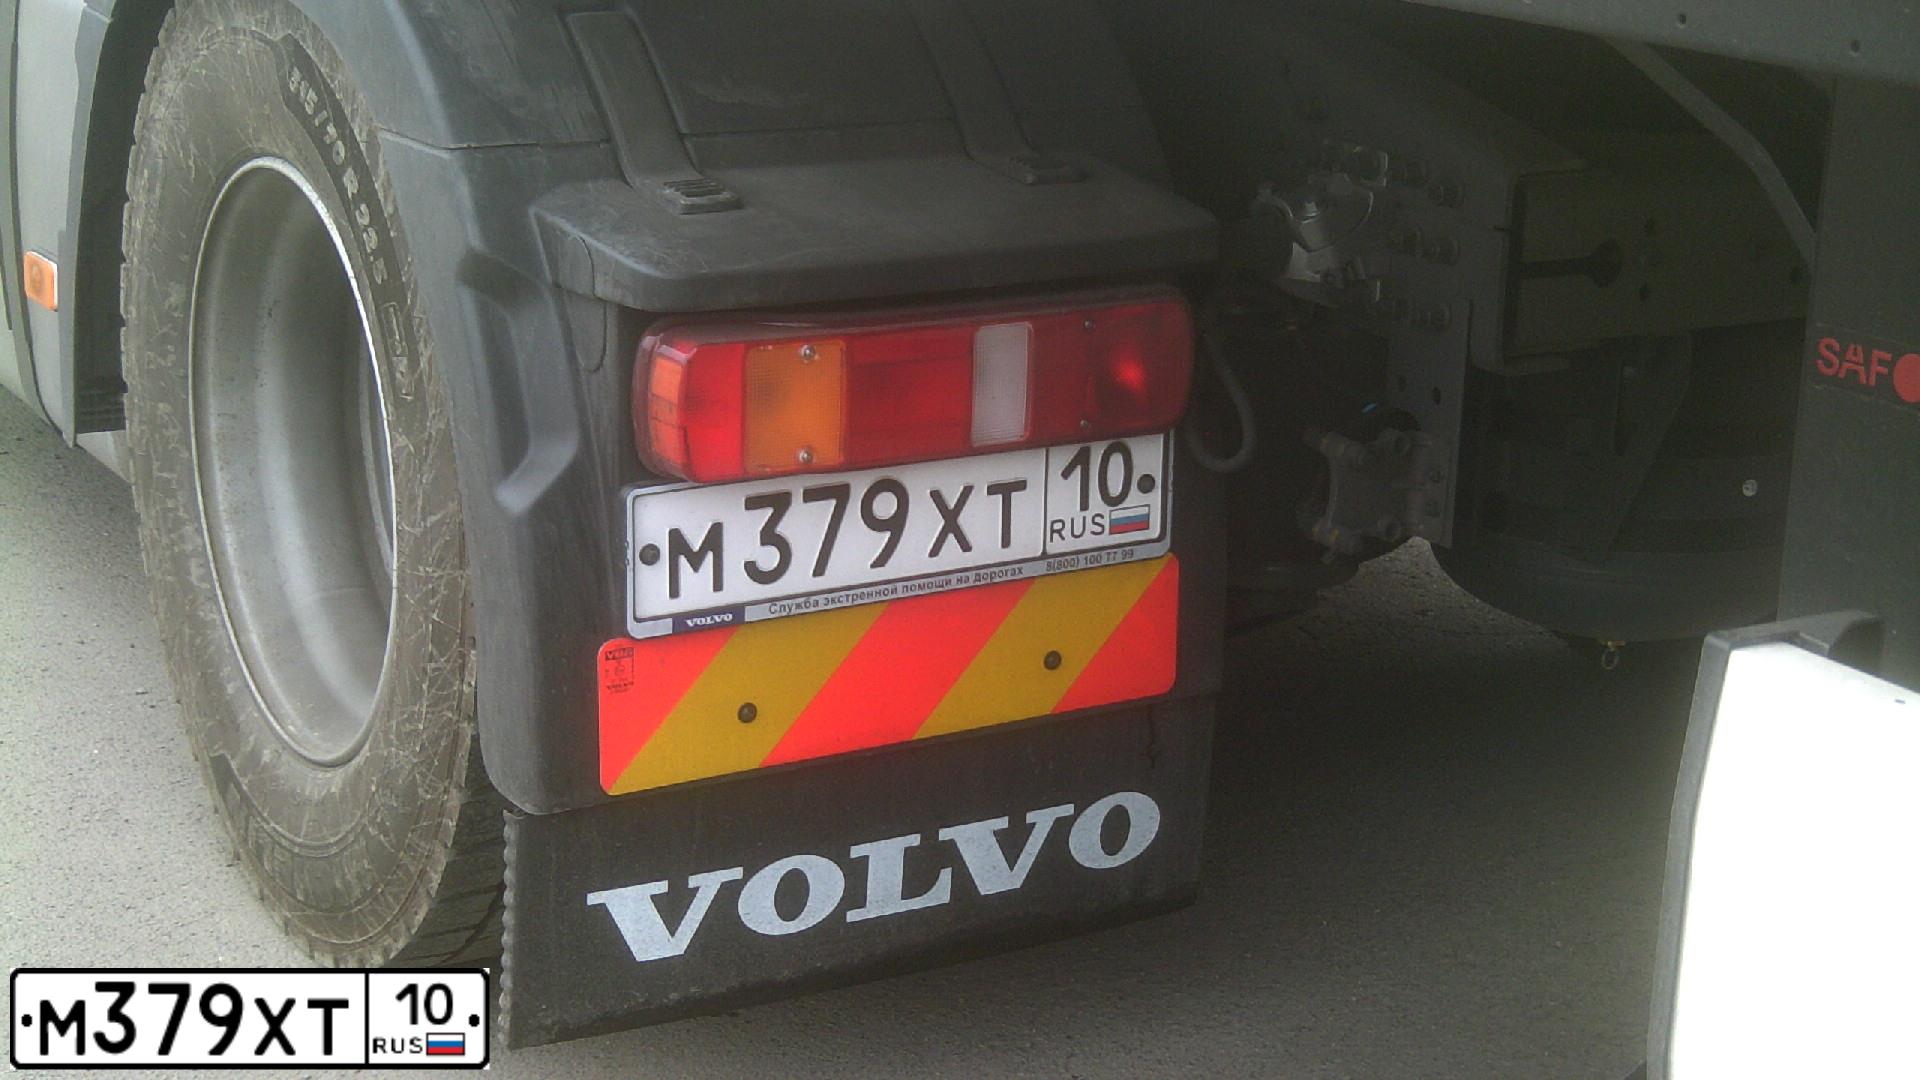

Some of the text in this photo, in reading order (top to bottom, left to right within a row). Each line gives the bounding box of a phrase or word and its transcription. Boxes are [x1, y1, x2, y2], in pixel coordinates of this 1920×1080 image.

[1816, 337, 1892, 386] SAF
[668, 441, 1133, 599] М379ХТ 10
[1049, 514, 1105, 543] RUS
[1045, 557, 1080, 573] 8(800)
[1083, 555, 1102, 566] 100
[1121, 550, 1135, 561] 99
[768, 566, 1024, 615] Служба экстренной помощи на дорогах
[686, 612, 733, 628] VOLVO
[587, 791, 1160, 962] VOLVO
